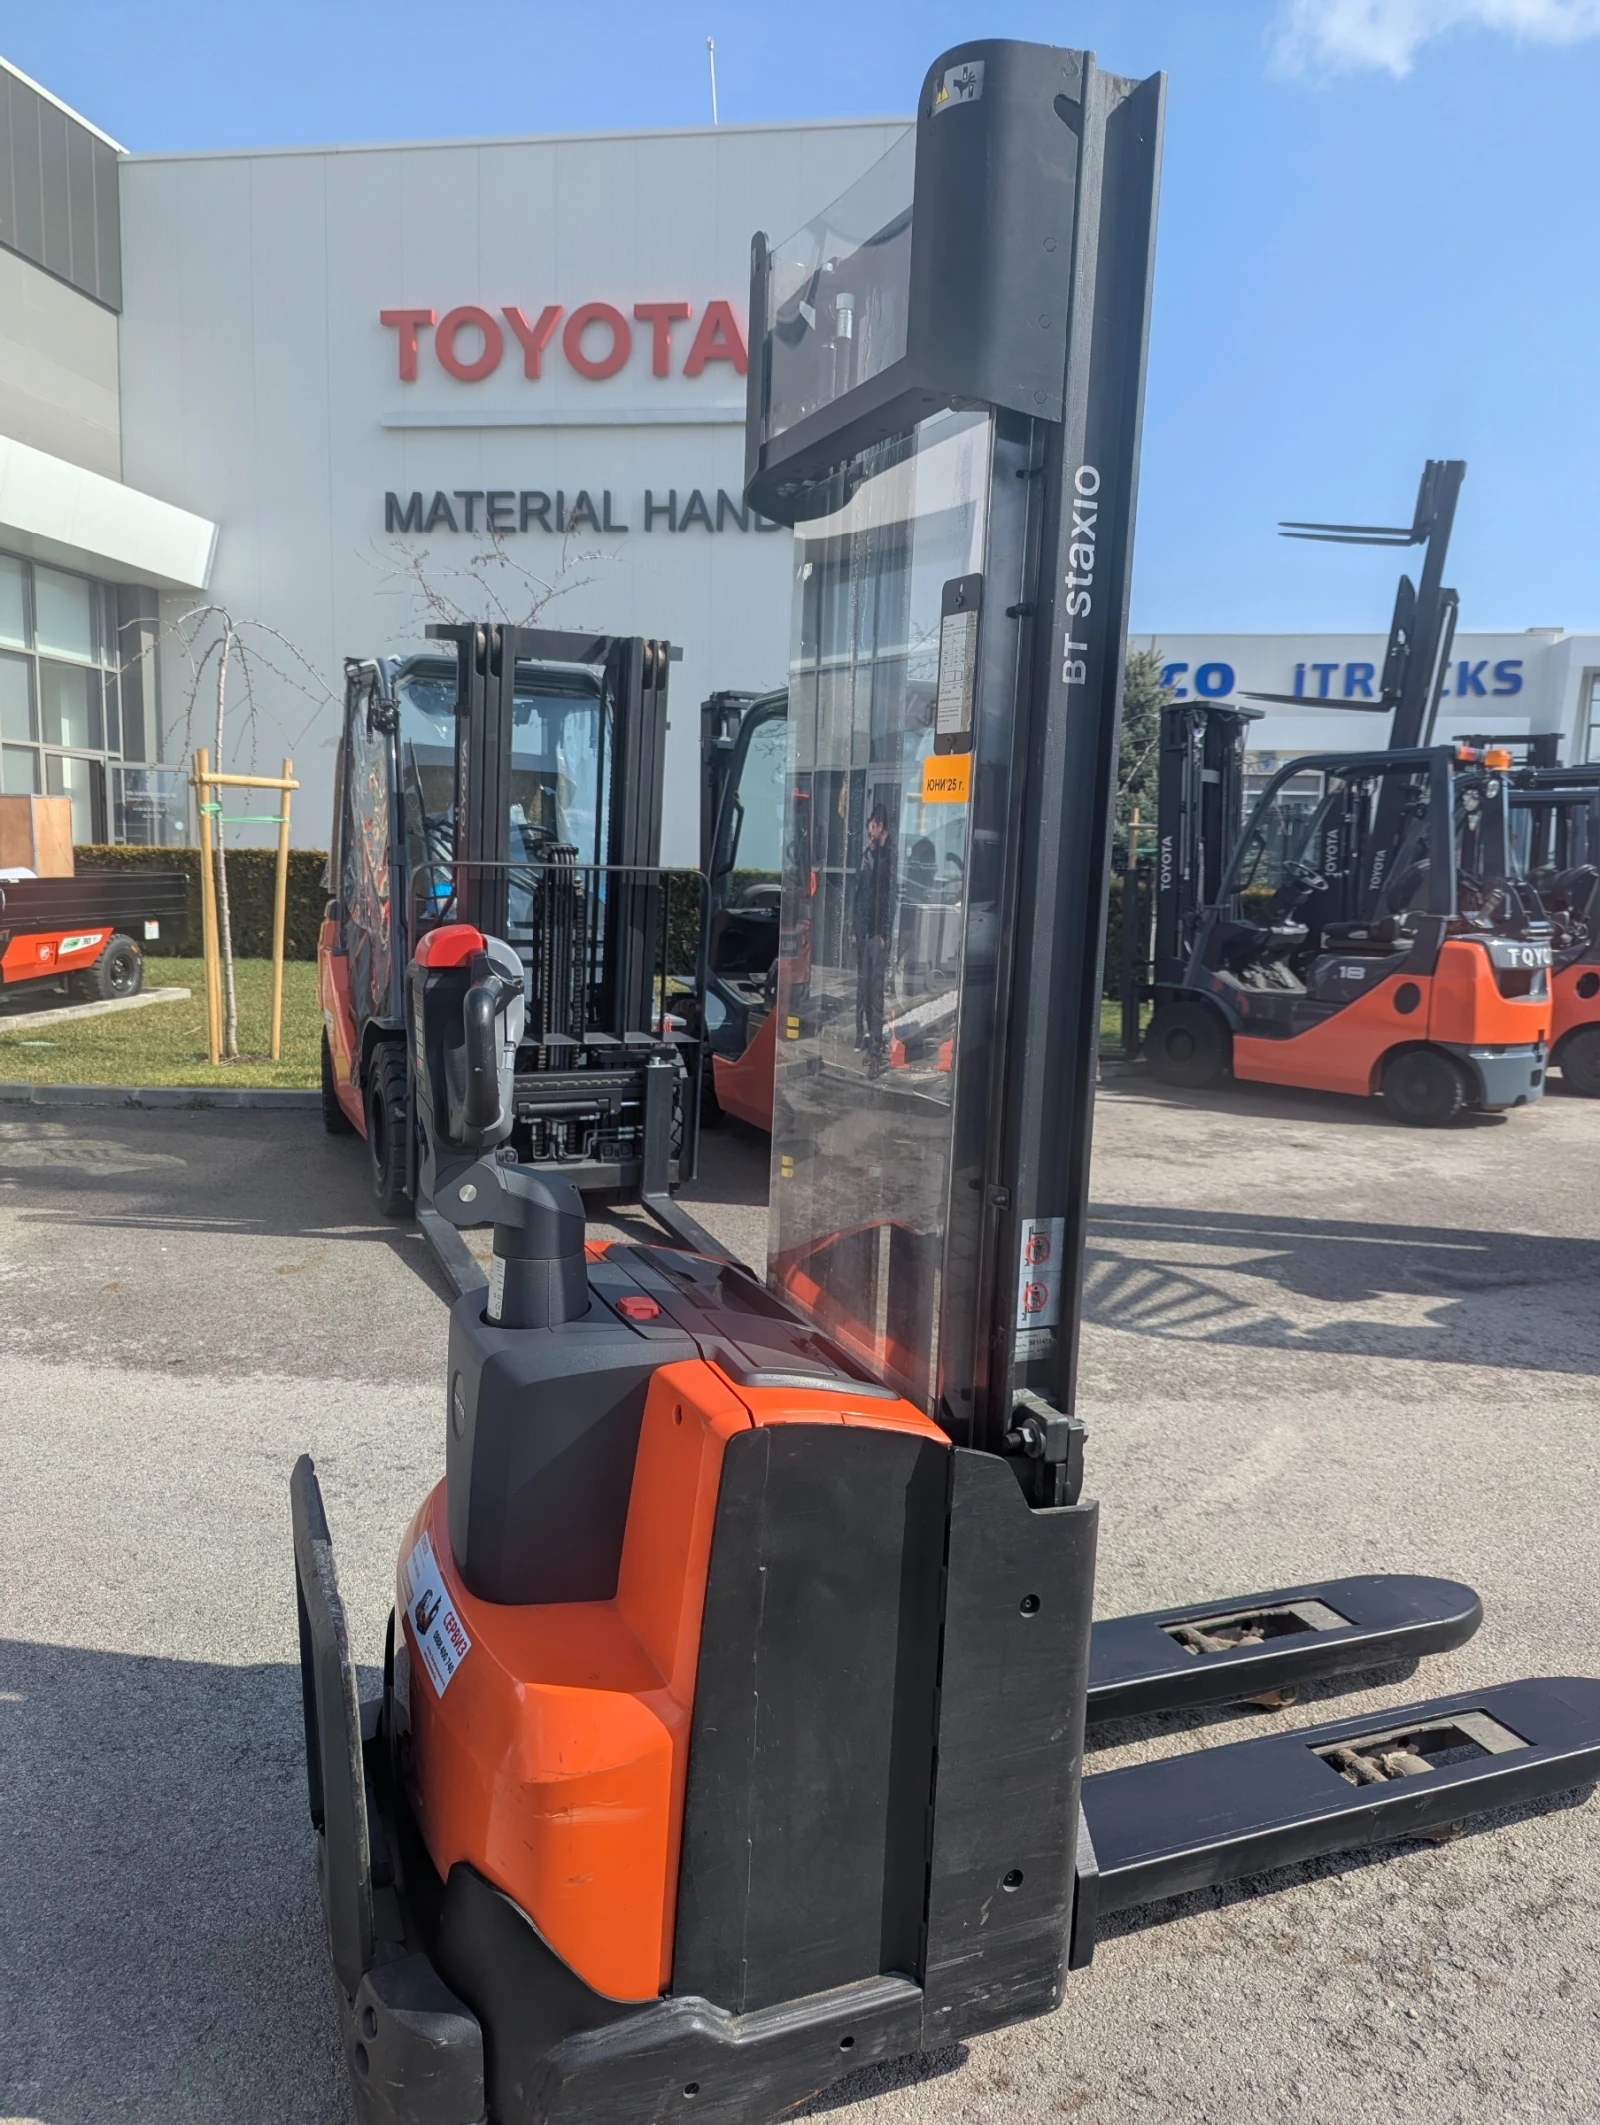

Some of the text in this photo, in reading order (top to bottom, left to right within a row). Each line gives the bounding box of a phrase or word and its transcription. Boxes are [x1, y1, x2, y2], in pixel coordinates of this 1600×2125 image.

[380, 301, 748, 381] TOYOTA
[385, 489, 629, 534] MATERIAL
[1062, 465, 1101, 685] BT staxio
[1293, 659, 1524, 698] iTRKS
[460, 740, 468, 841] TOYOTA
[1160, 836, 1173, 892] TOYOTA
[1325, 829, 1339, 876] TOYOTA
[1368, 850, 1387, 890] TOYOTA
[1338, 966, 1366, 980] 18
[443, 1611, 468, 1657] СЕРВИЗ
